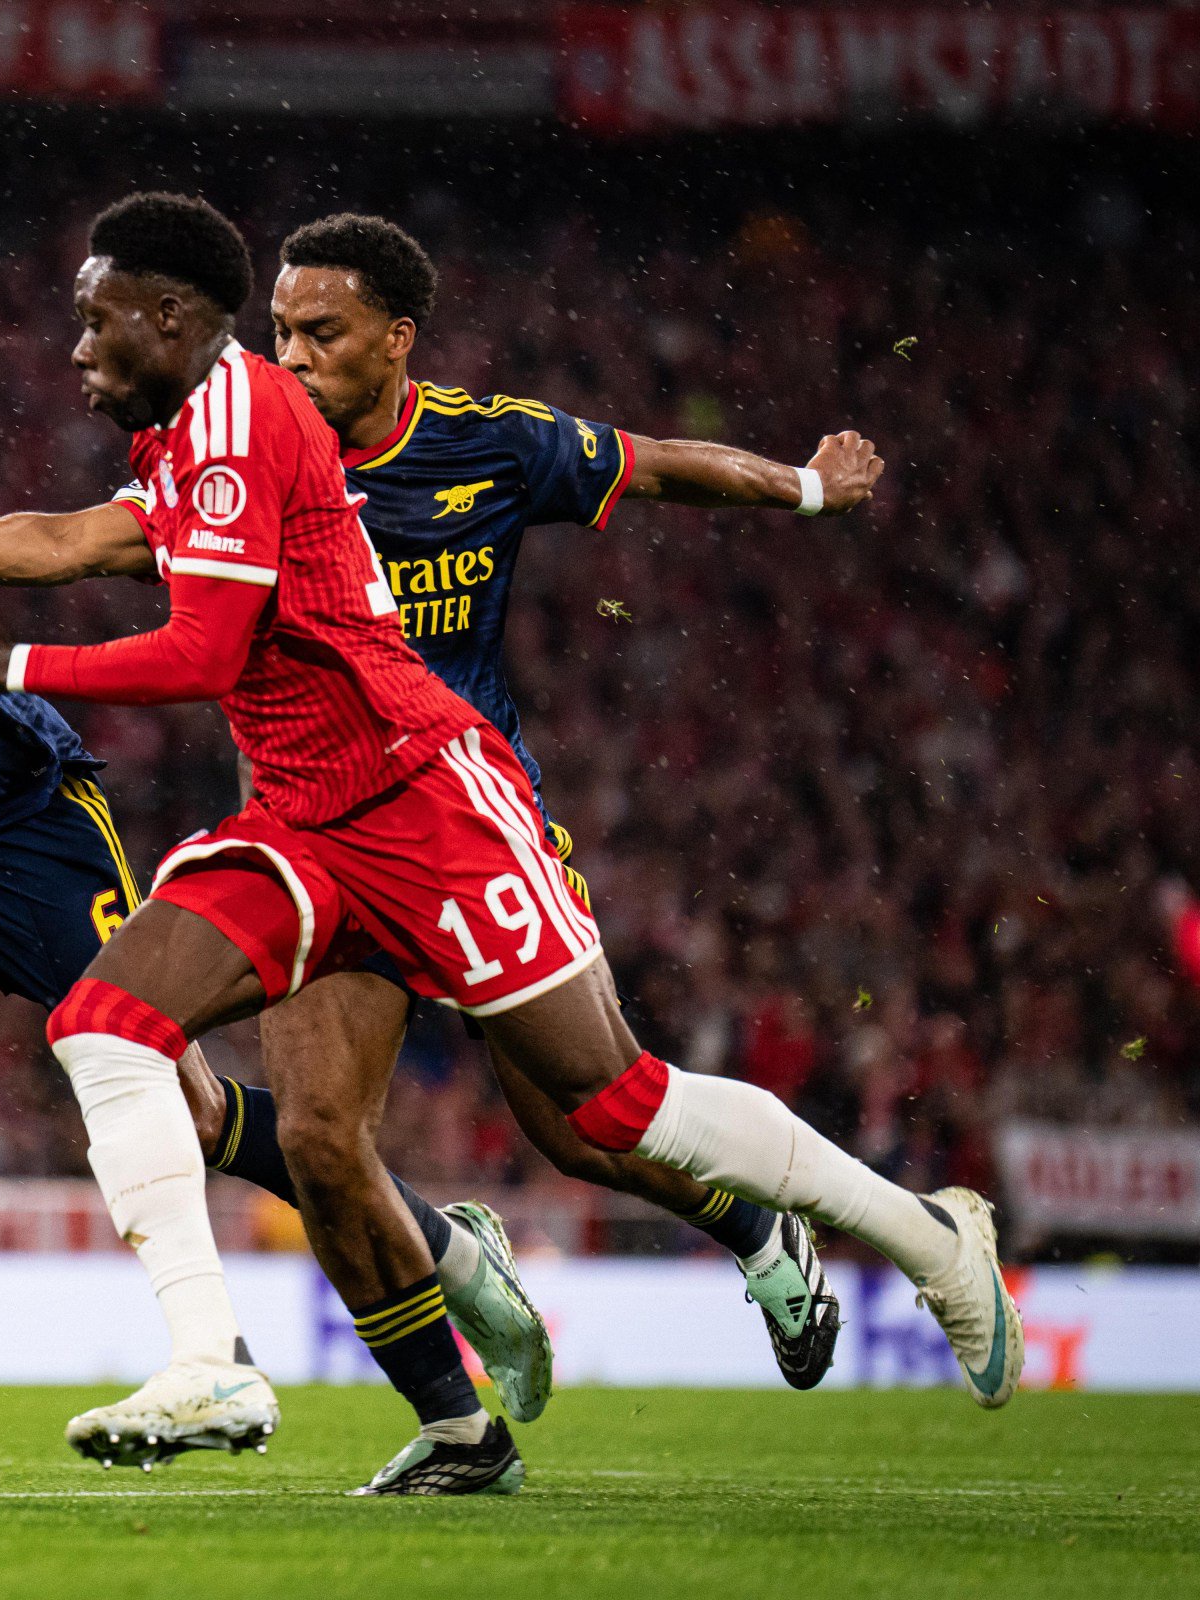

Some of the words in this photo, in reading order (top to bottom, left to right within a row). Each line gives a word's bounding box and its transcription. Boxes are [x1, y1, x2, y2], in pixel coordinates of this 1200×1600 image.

[187, 529, 246, 554] Allianz
[376, 546, 495, 596] rates
[400, 595, 472, 640] ETTER
[90, 888, 126, 945] 6
[437, 872, 543, 987] 19
